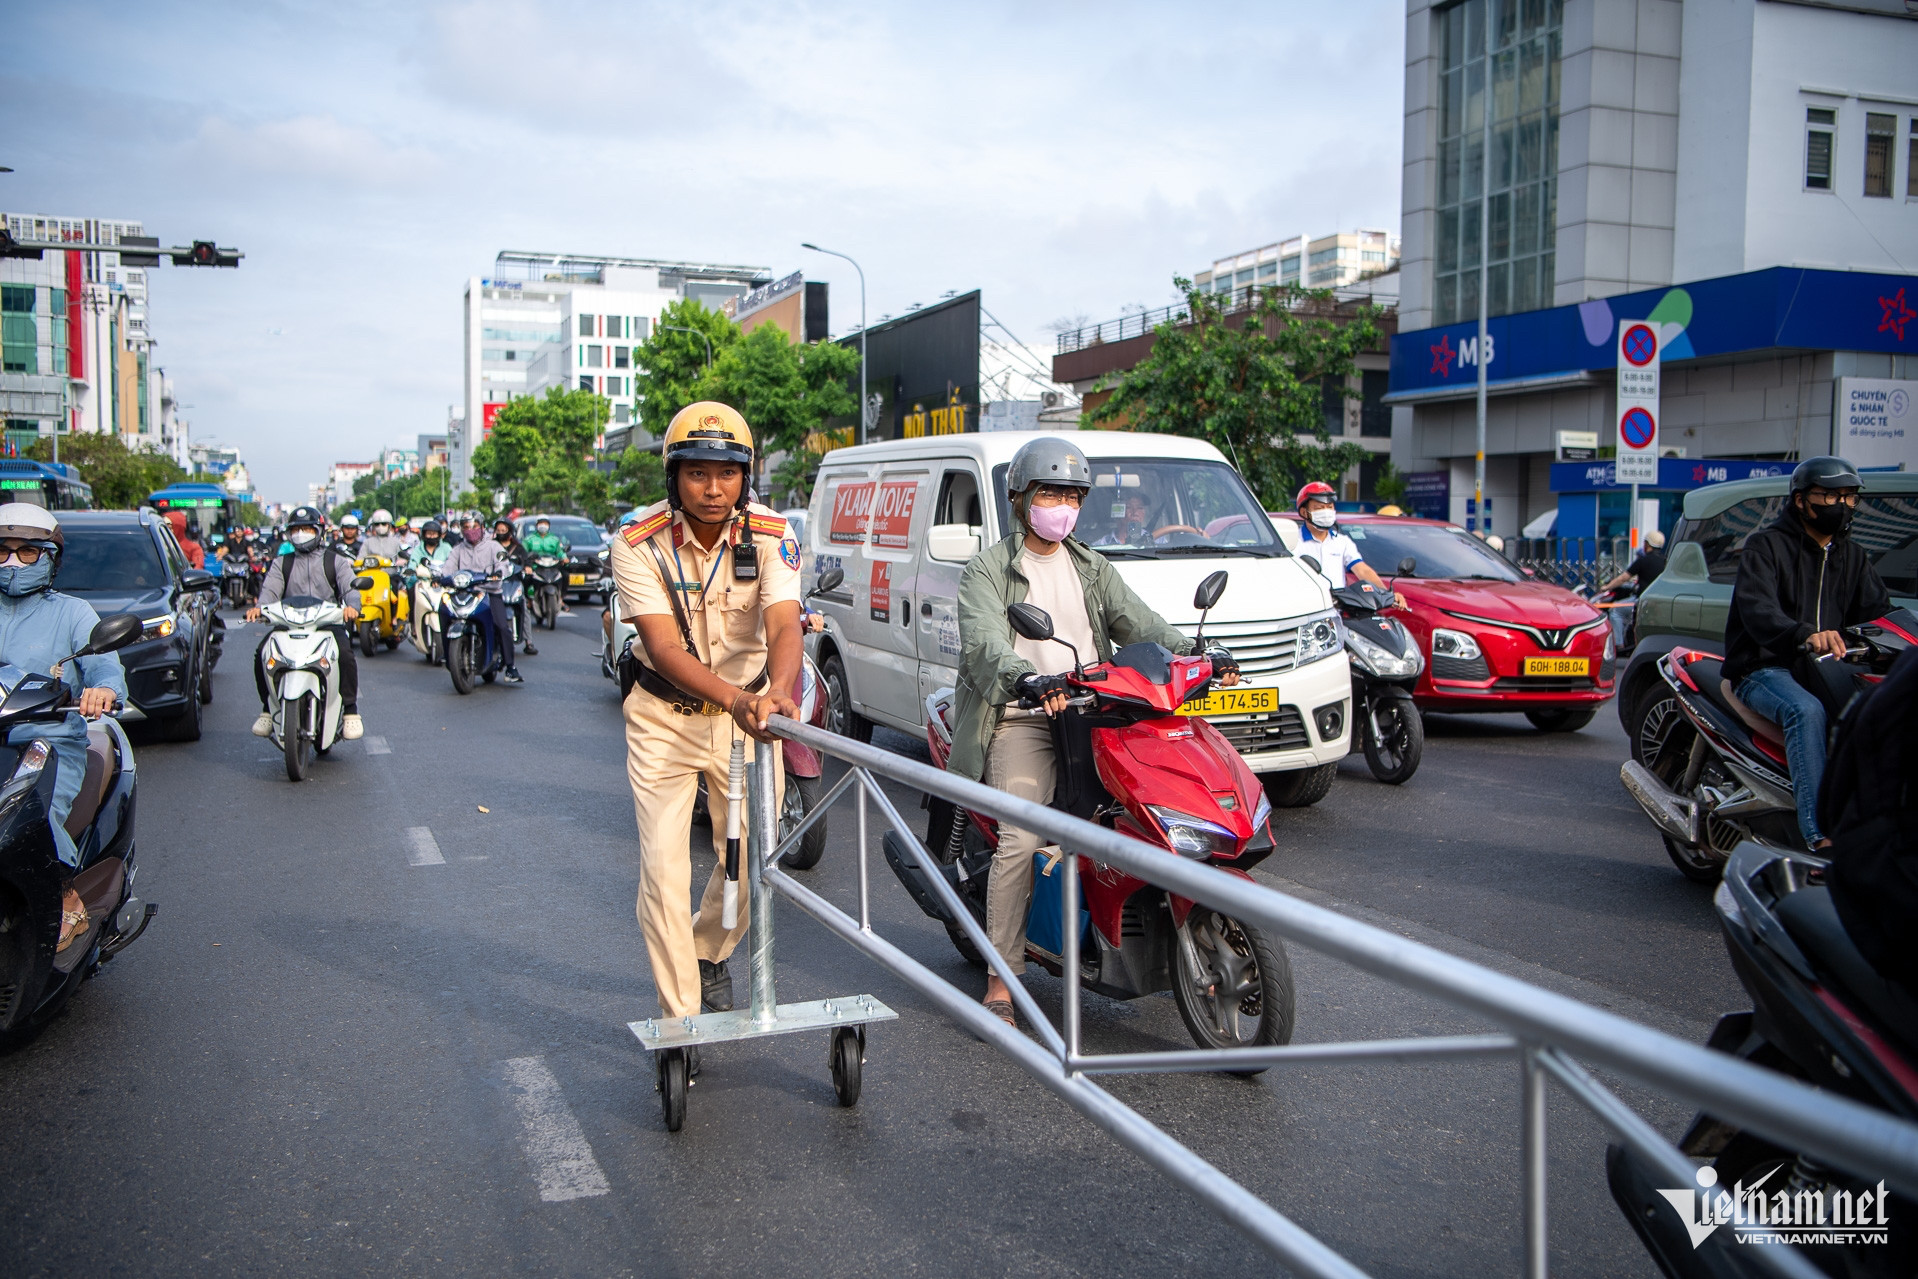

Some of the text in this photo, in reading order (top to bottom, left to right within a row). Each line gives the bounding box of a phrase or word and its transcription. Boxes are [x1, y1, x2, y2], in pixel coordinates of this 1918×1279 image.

[1458, 334, 1495, 368] MB
[1586, 467, 1605, 480] ATM
[1707, 467, 1727, 481] MB
[1749, 468, 1768, 479] ATM
[1530, 661, 1584, 673] 60H-188.04
